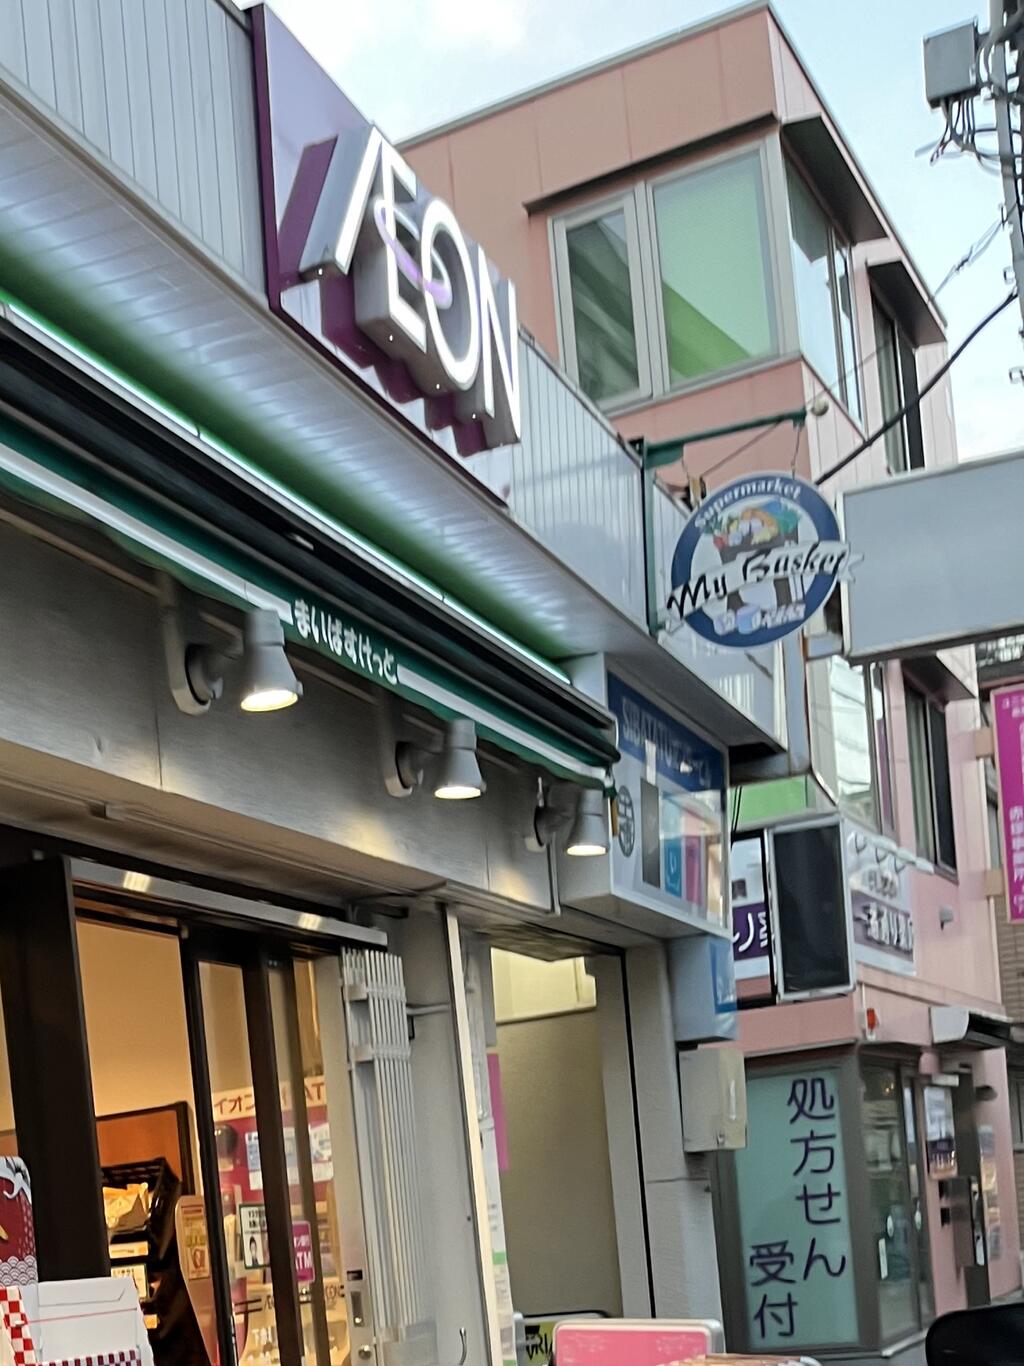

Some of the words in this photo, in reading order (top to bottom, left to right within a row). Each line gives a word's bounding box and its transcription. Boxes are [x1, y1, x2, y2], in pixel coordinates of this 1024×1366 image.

[326, 125, 521, 441] AEON
[694, 478, 802, 529] Supermarket
[666, 573, 728, 620] My
[741, 540, 848, 583] Basket
[294, 600, 397, 685] まいばすけっと
[787, 1077, 846, 1282] 処方せん
[749, 1240, 798, 1339] 受付
